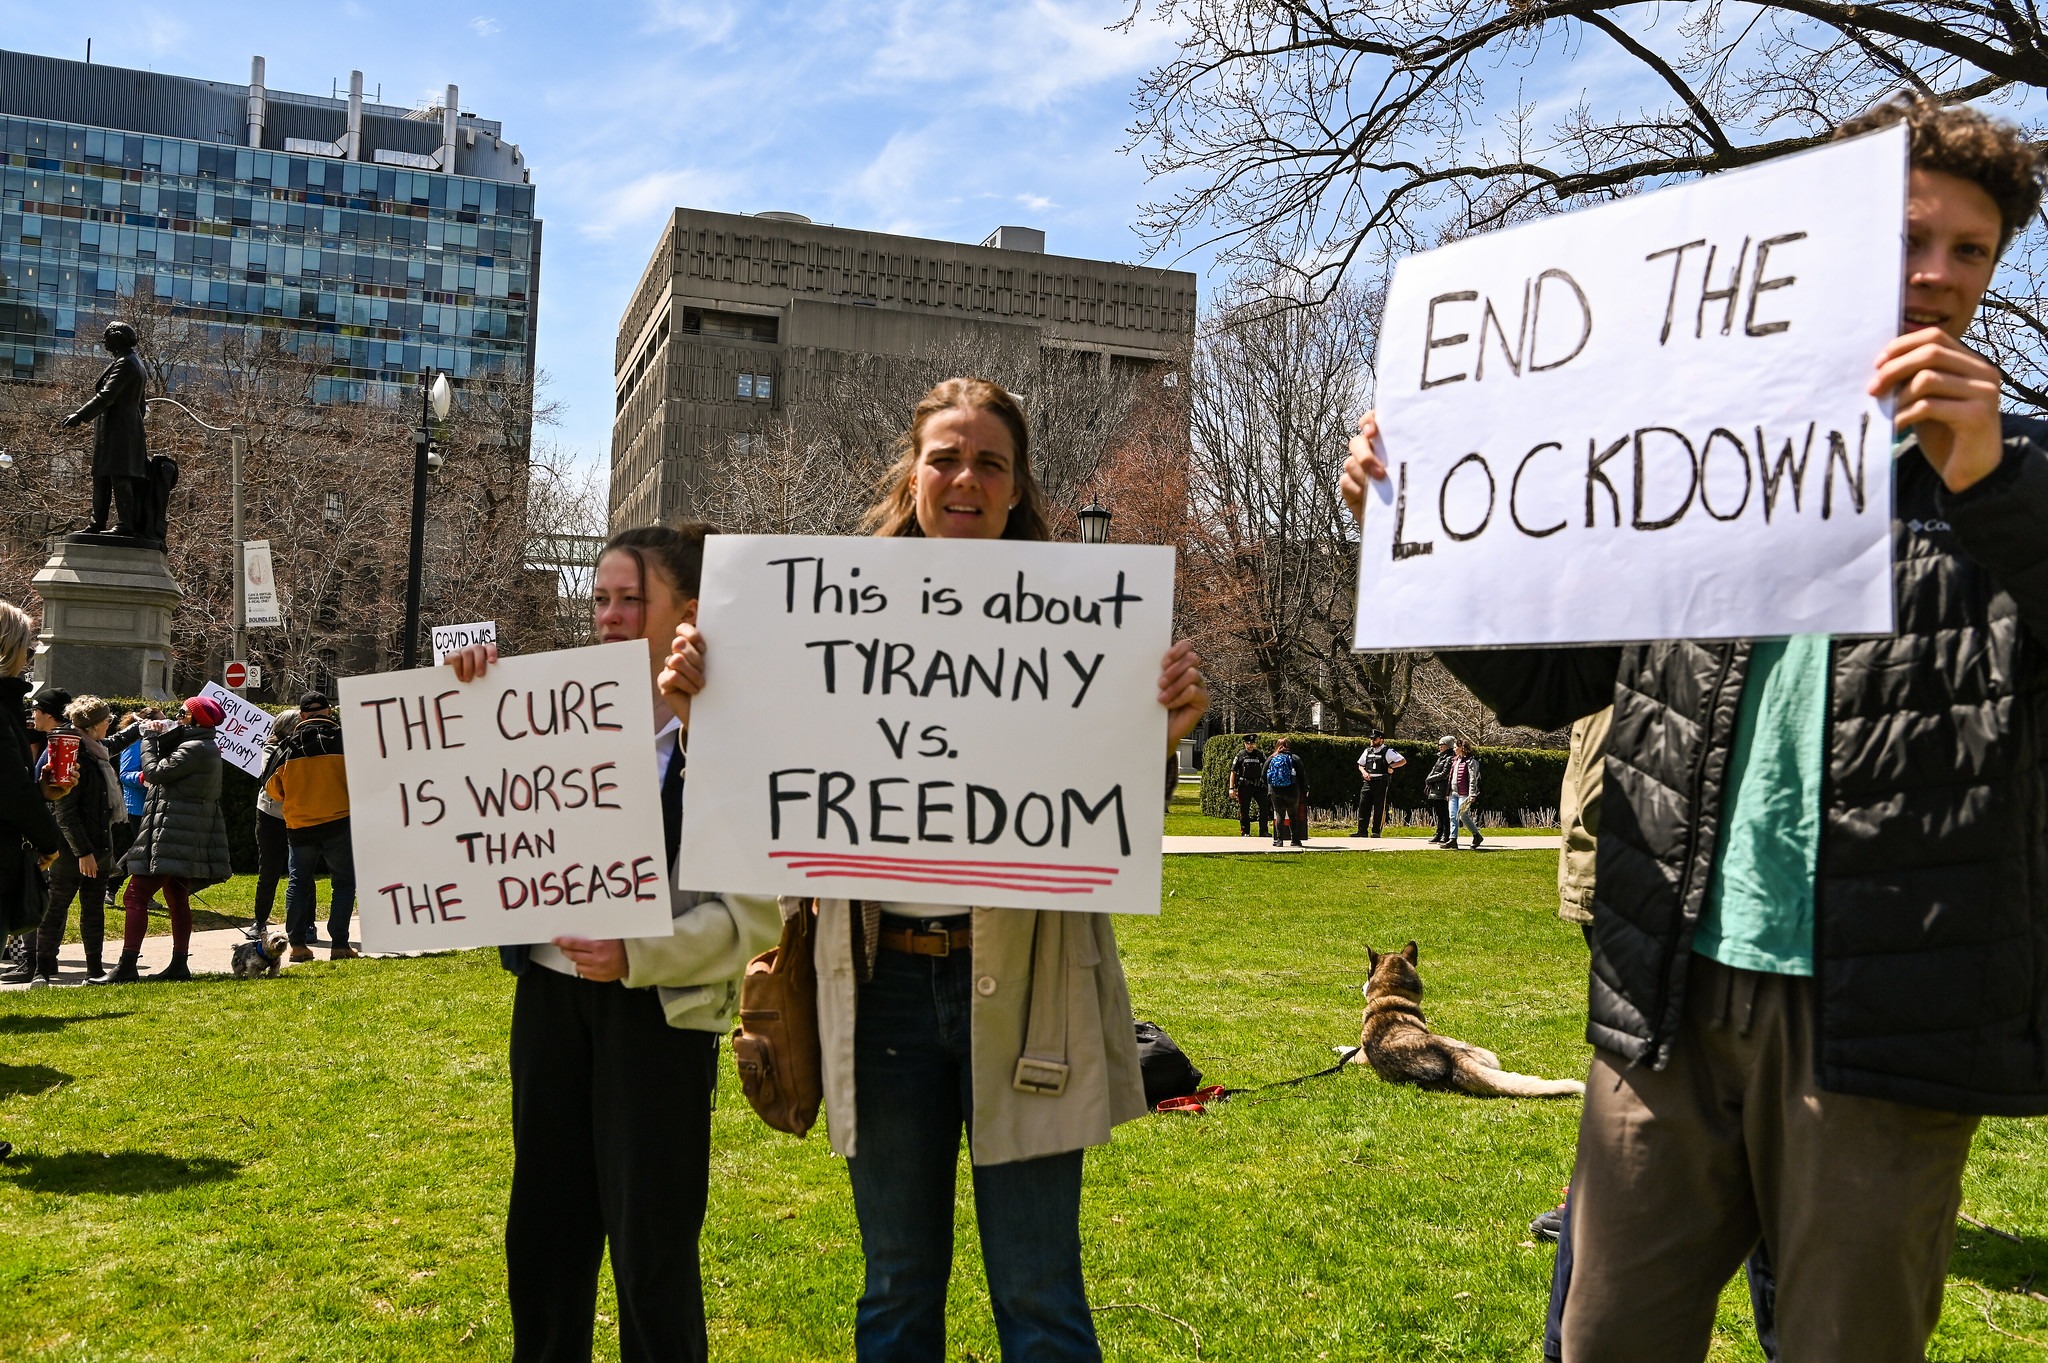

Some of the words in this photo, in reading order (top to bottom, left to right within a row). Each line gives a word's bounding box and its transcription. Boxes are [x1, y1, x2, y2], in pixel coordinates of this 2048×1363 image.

[1420, 268, 1592, 390] END
[1645, 231, 1807, 346] THE
[1391, 412, 1870, 560] LOCKDOWN
[766, 557, 888, 615] This
[921, 577, 963, 616] is
[982, 570, 1144, 629] about
[212, 690, 242, 716] SIGN
[244, 710, 262, 725] UP
[804, 638, 1105, 709] TYRANNY
[225, 717, 249, 736] DIE
[360, 690, 466, 759] THE
[497, 680, 623, 741] CURE
[400, 779, 446, 827] IS
[465, 762, 623, 817] WORSE
[768, 768, 1132, 857] FREEDOM
[456, 828, 555, 865] THAN
[378, 883, 466, 925] THE
[498, 856, 660, 912] DISEASE
